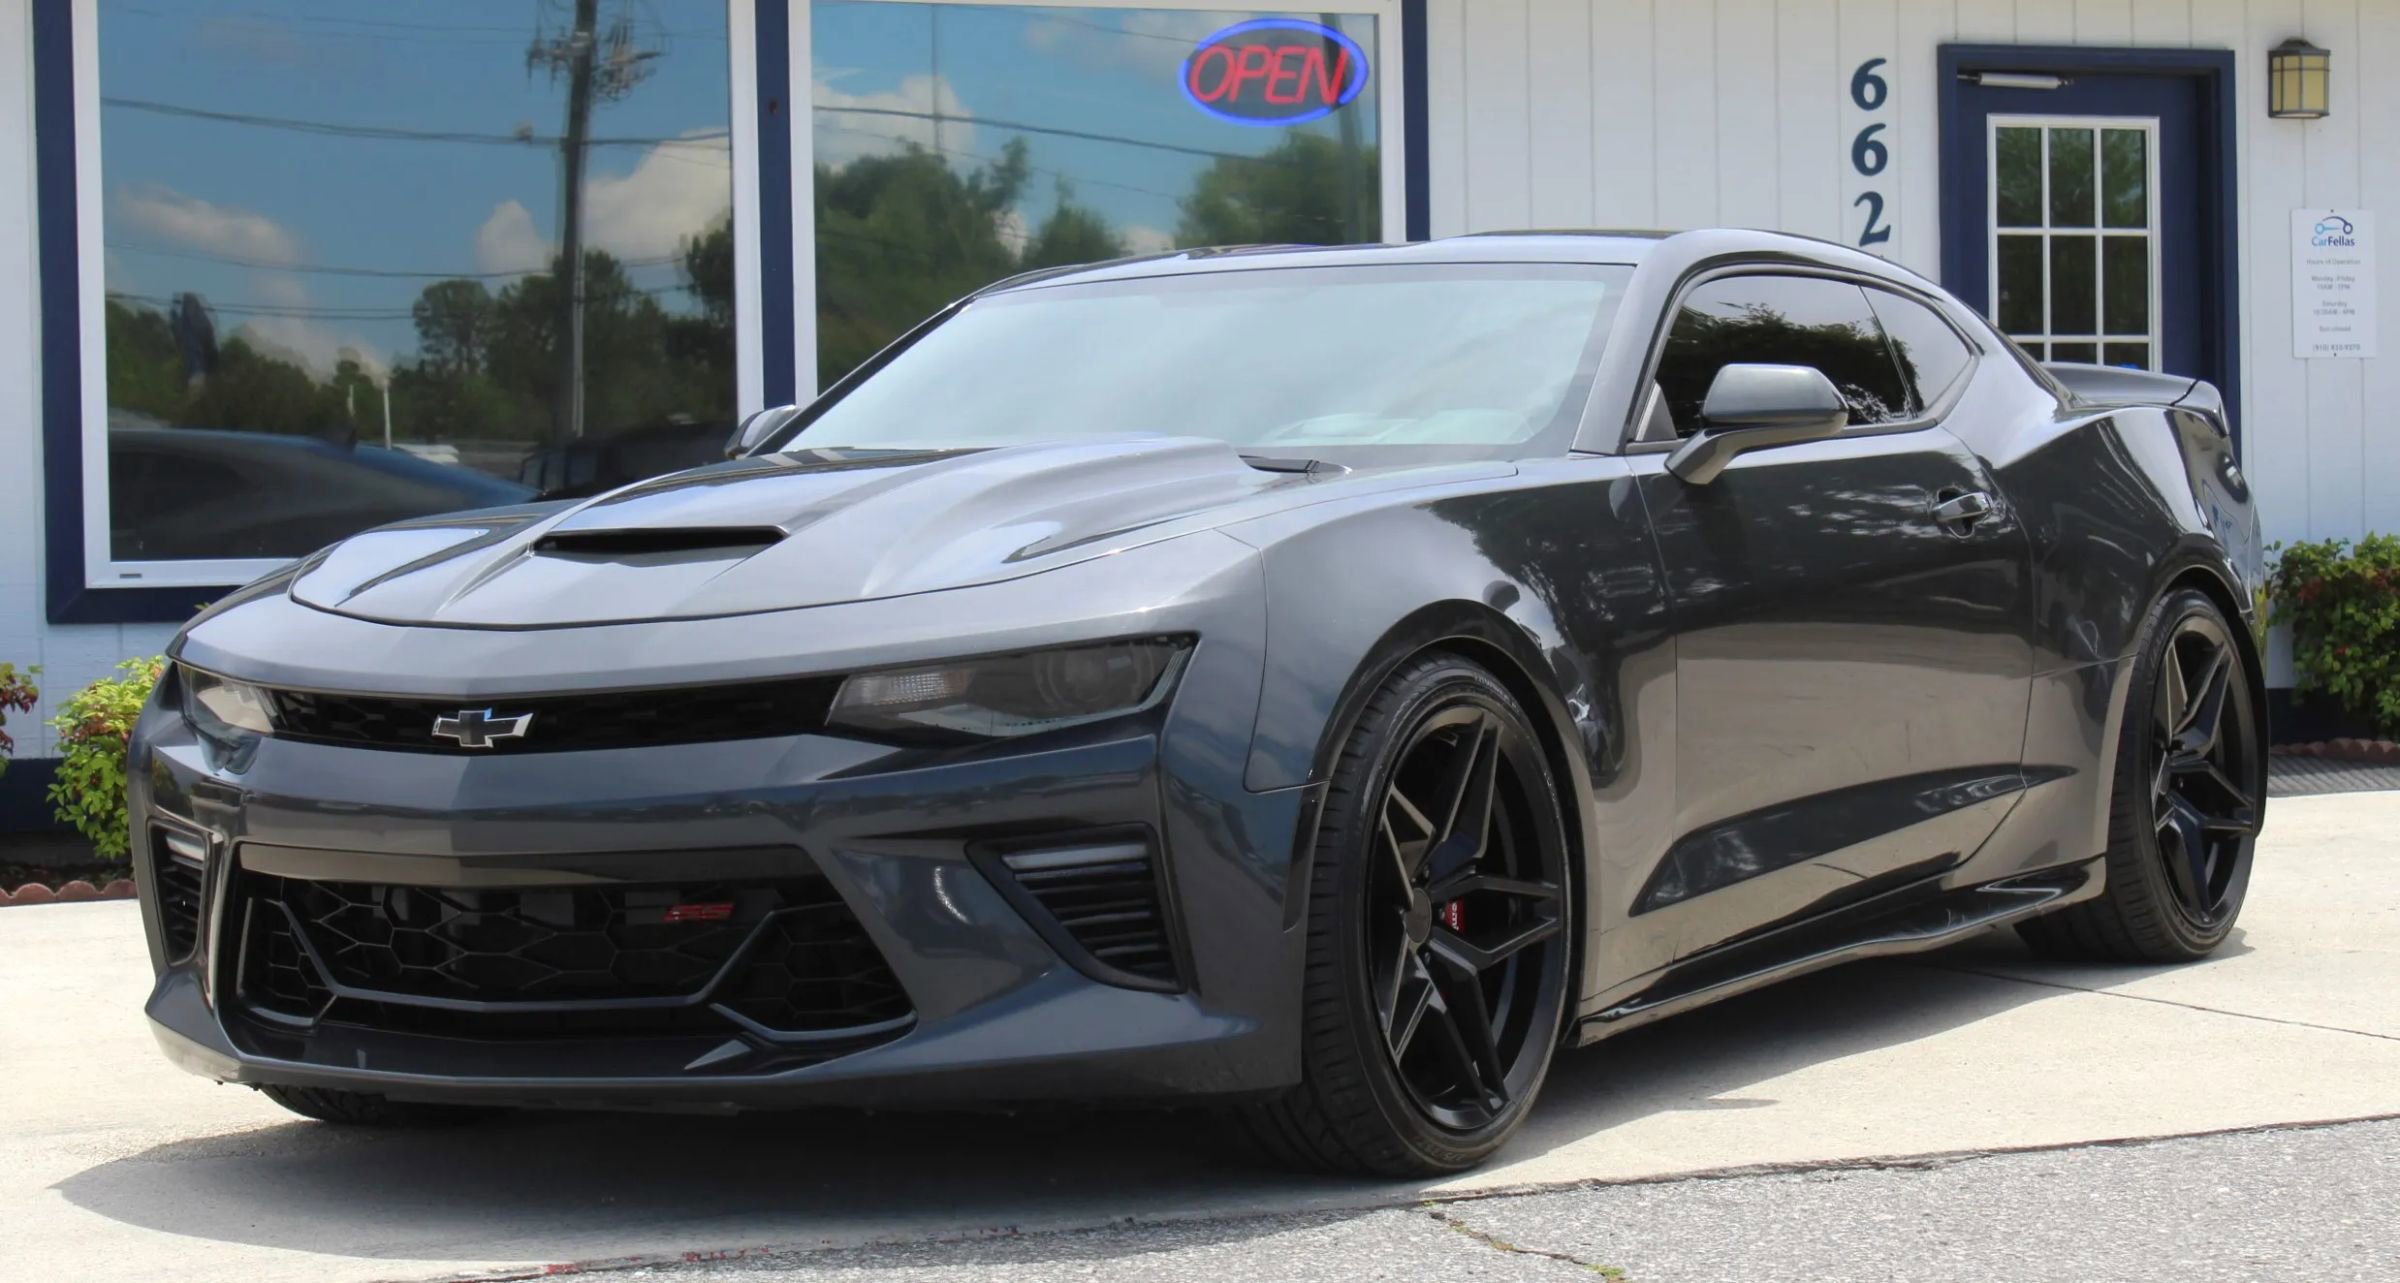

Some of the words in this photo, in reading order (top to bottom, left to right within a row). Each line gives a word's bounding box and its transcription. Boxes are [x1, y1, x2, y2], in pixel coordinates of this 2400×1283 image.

[1189, 44, 1349, 105] OPEN
[1851, 57, 1891, 247] 662
[2311, 235, 2356, 247] CarFellas
